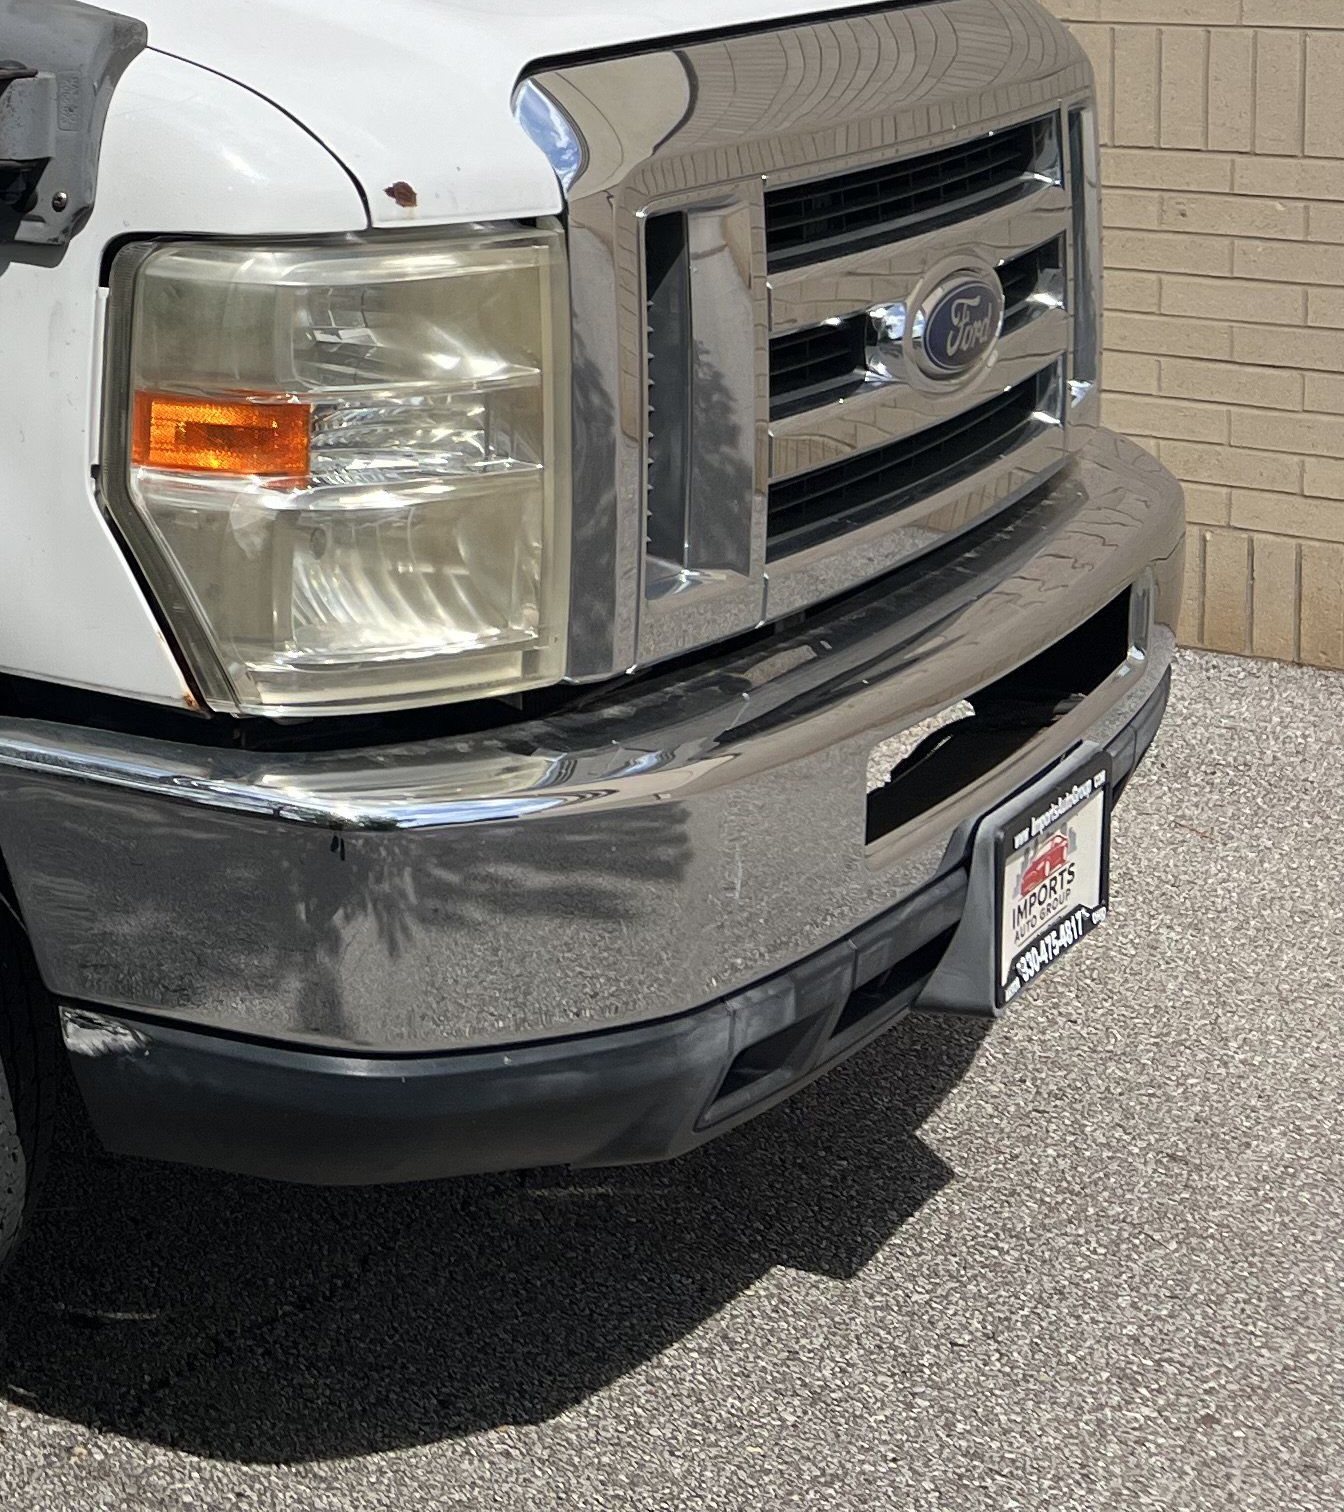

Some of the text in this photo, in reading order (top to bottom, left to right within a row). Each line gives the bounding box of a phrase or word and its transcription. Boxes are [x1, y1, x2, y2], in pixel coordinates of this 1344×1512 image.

[946, 295, 993, 356] Ford
[1012, 862, 1076, 930] IMPORTS
[1014, 888, 1071, 943] AUTO GROUP
